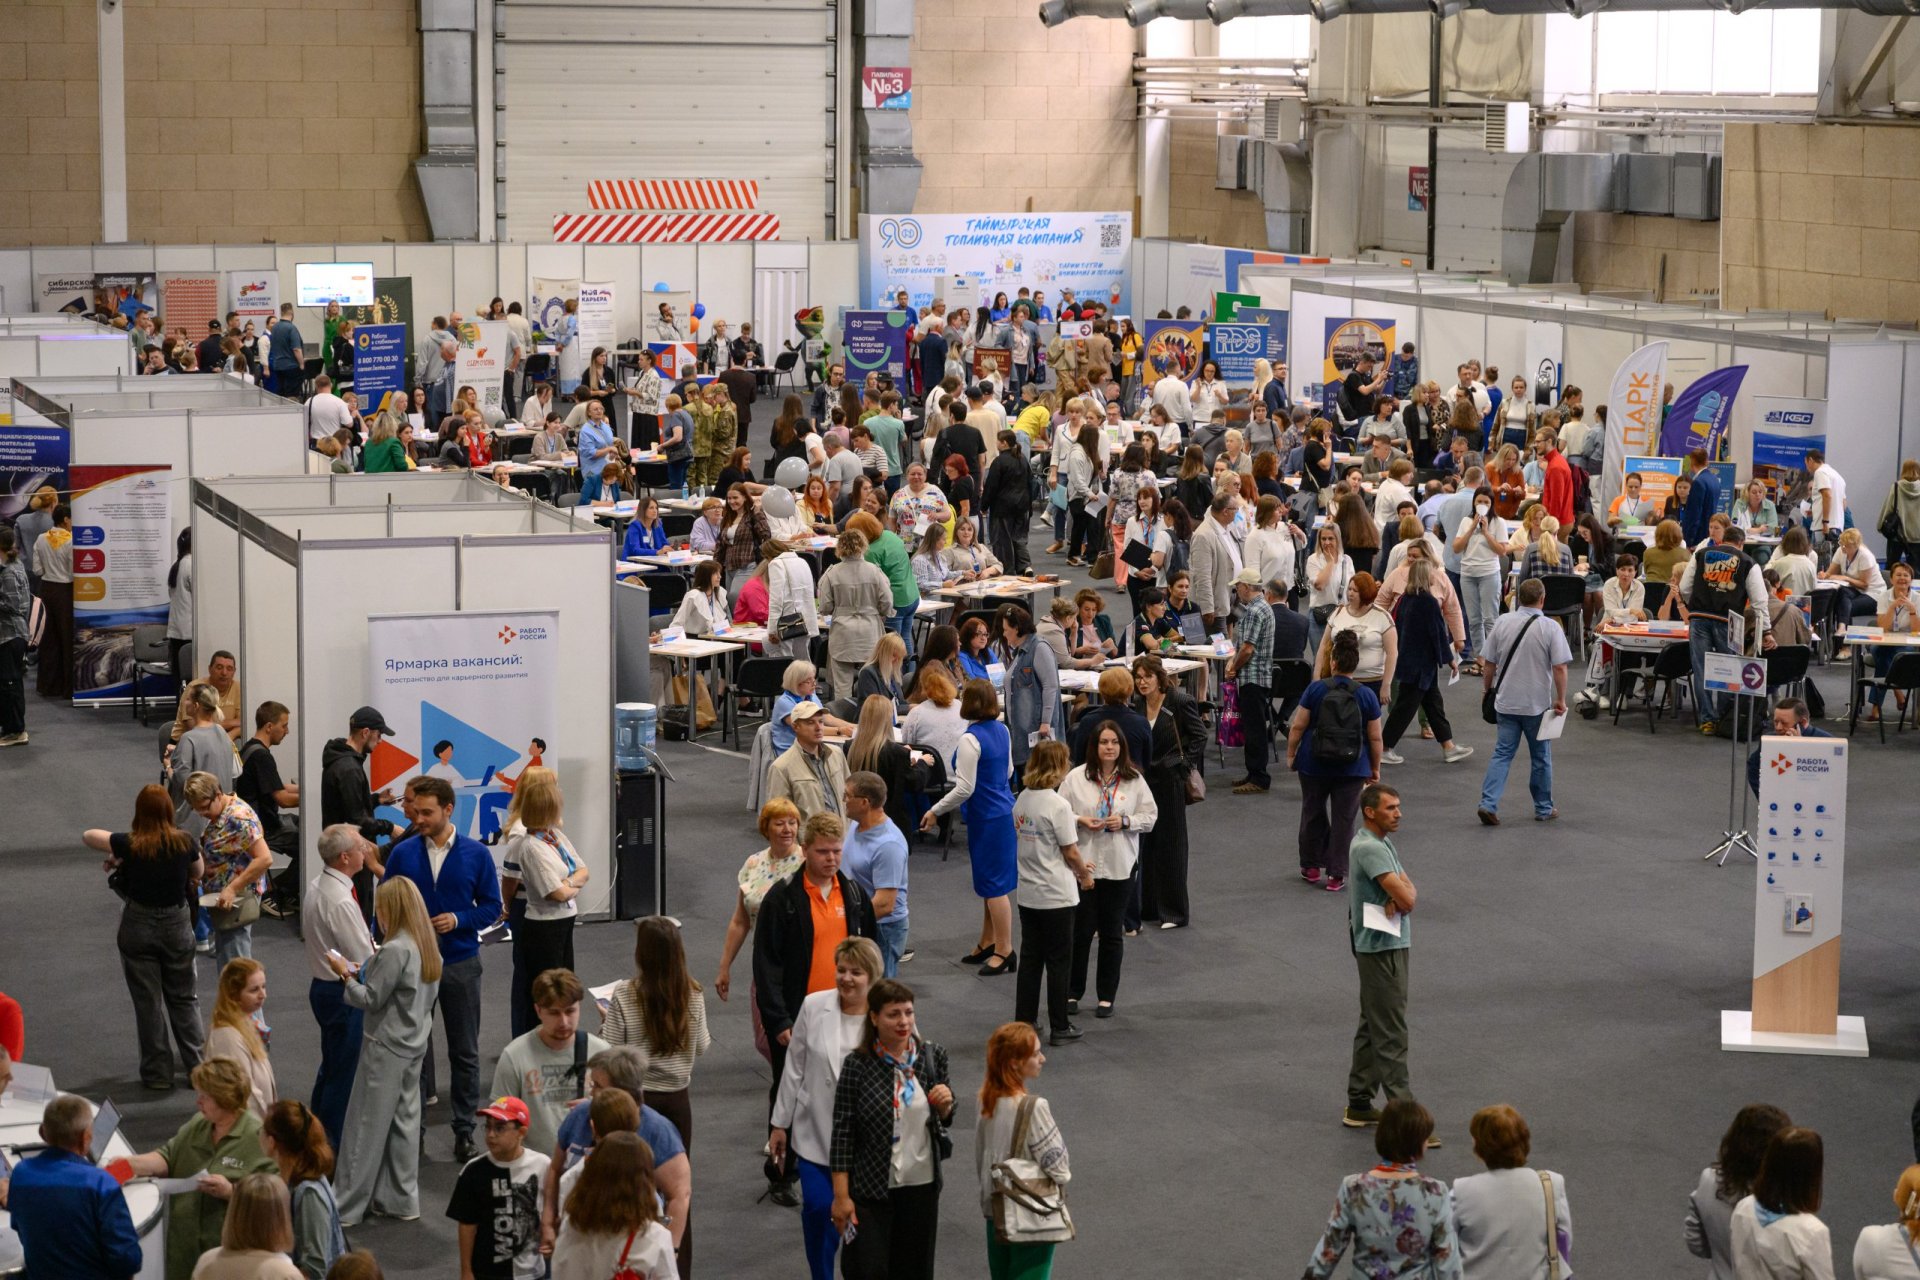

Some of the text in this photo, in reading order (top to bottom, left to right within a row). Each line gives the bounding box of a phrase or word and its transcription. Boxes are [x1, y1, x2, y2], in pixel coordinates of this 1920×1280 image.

[871, 78, 904, 94] №3
[965, 215, 1051, 231] ТАЙМЫРСКАЯ
[944, 228, 1085, 248] ТОПЛИВНАЯ КОМПАНИЯ
[1216, 327, 1260, 354] RDS
[1623, 371, 1651, 446] ПАРК
[385, 654, 522, 671] Ярмарка вакансий:
[385, 671, 529, 685] пространство для карьерного развития
[491, 1178, 515, 1264] WOLF
